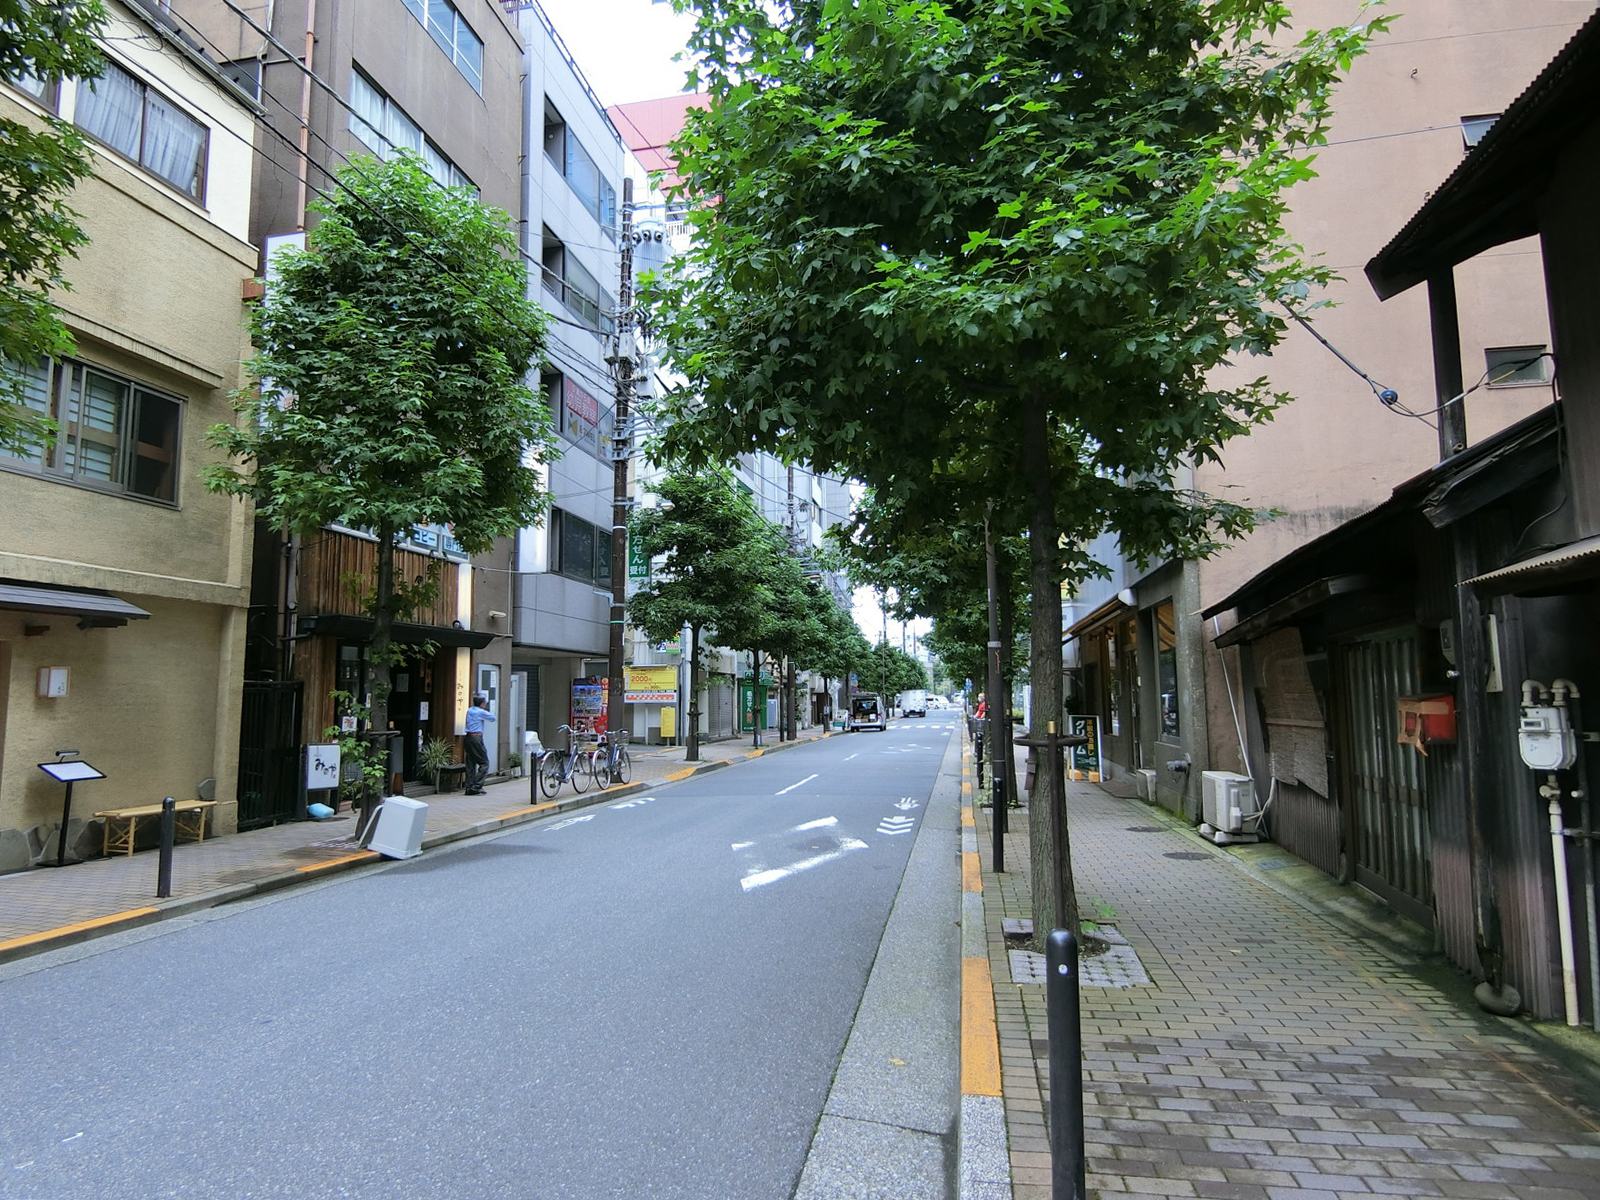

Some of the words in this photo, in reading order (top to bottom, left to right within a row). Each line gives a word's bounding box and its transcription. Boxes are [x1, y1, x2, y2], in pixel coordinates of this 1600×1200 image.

[629, 564, 647, 575] 受付
[1075, 719, 1087, 756] クリム
